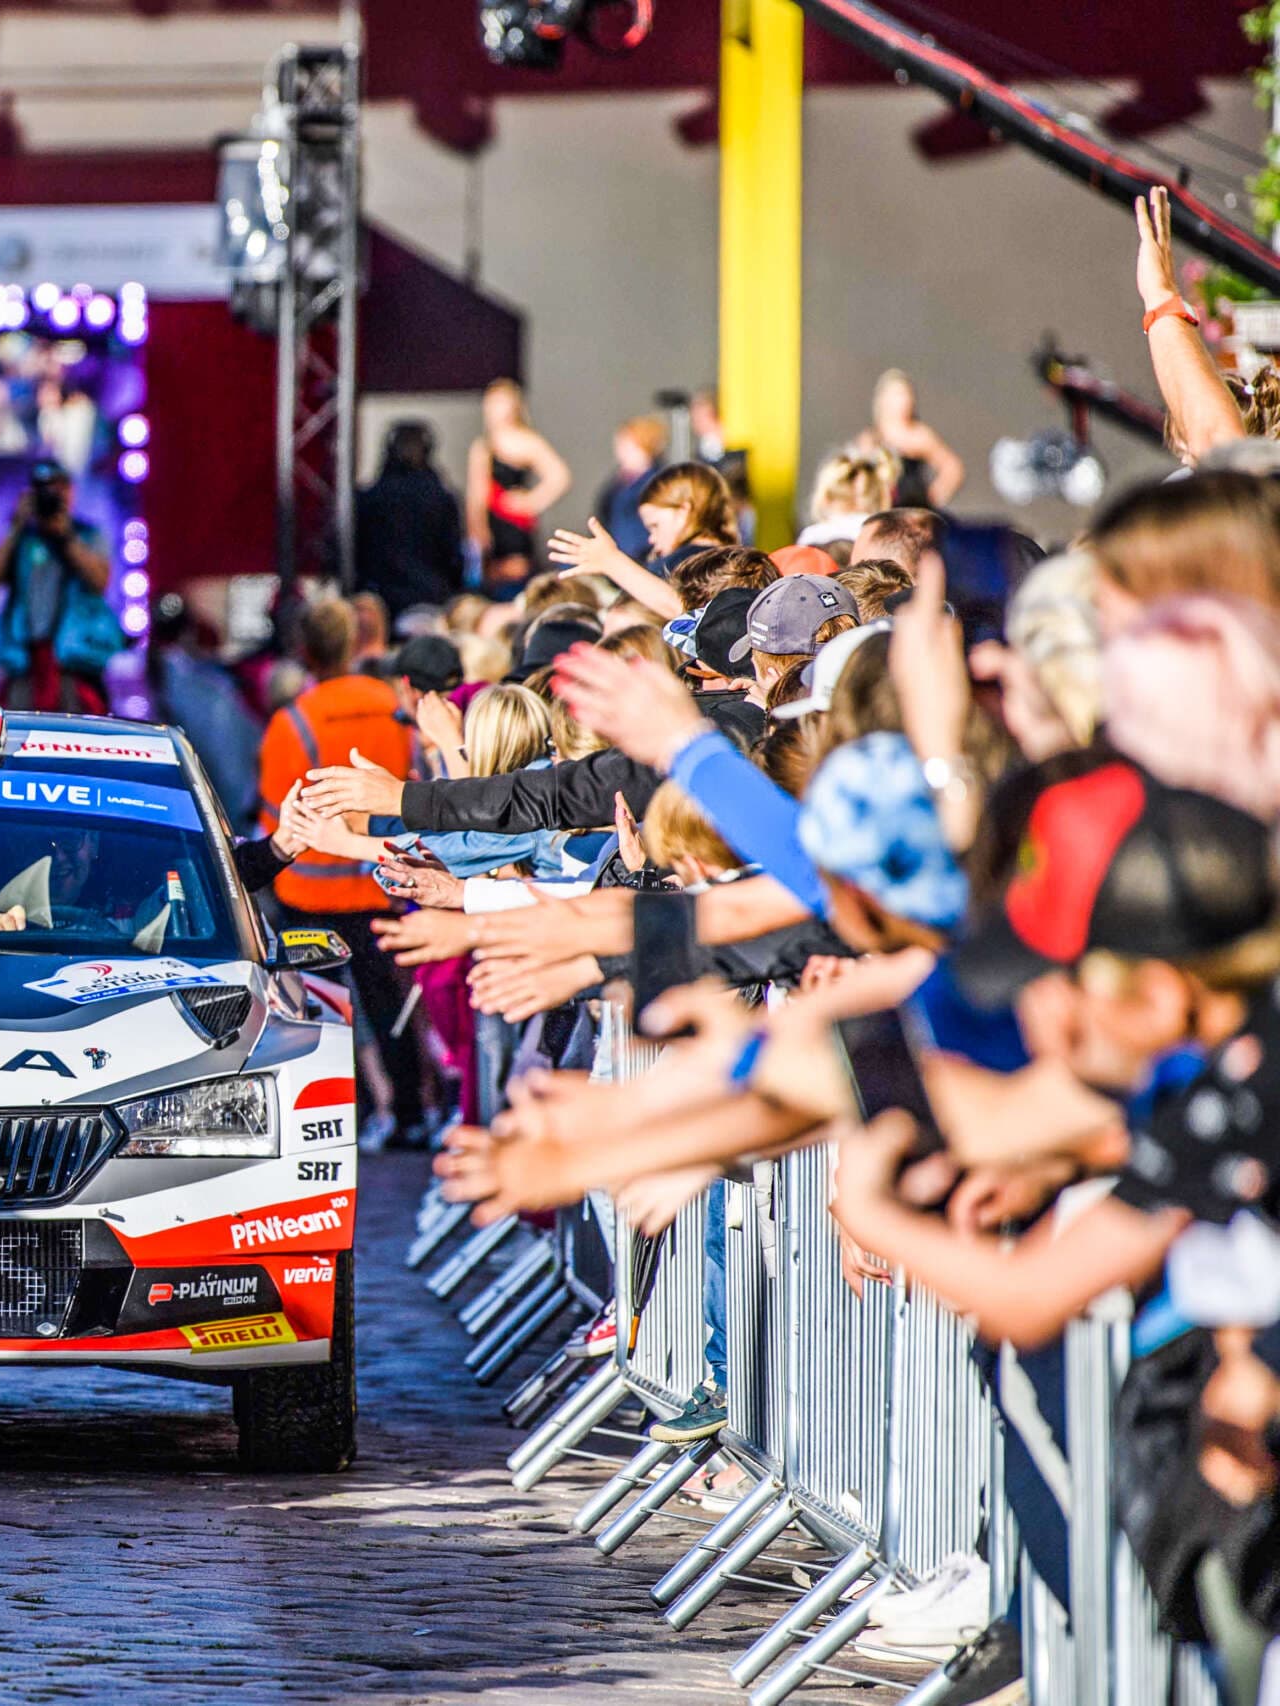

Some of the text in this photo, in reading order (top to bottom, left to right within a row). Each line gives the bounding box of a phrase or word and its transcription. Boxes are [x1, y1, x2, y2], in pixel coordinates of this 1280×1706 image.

[20, 742, 152, 759] PFNteam
[1, 781, 92, 806] LIVE
[77, 971, 183, 994] ESTONIA
[301, 1117, 344, 1142] SRT
[297, 1161, 343, 1181] SRT
[230, 1196, 349, 1250] PFNteam 100
[283, 1266, 334, 1285] verva
[179, 1276, 258, 1300] PLATINUM
[191, 1315, 283, 1346] PIRELLI
